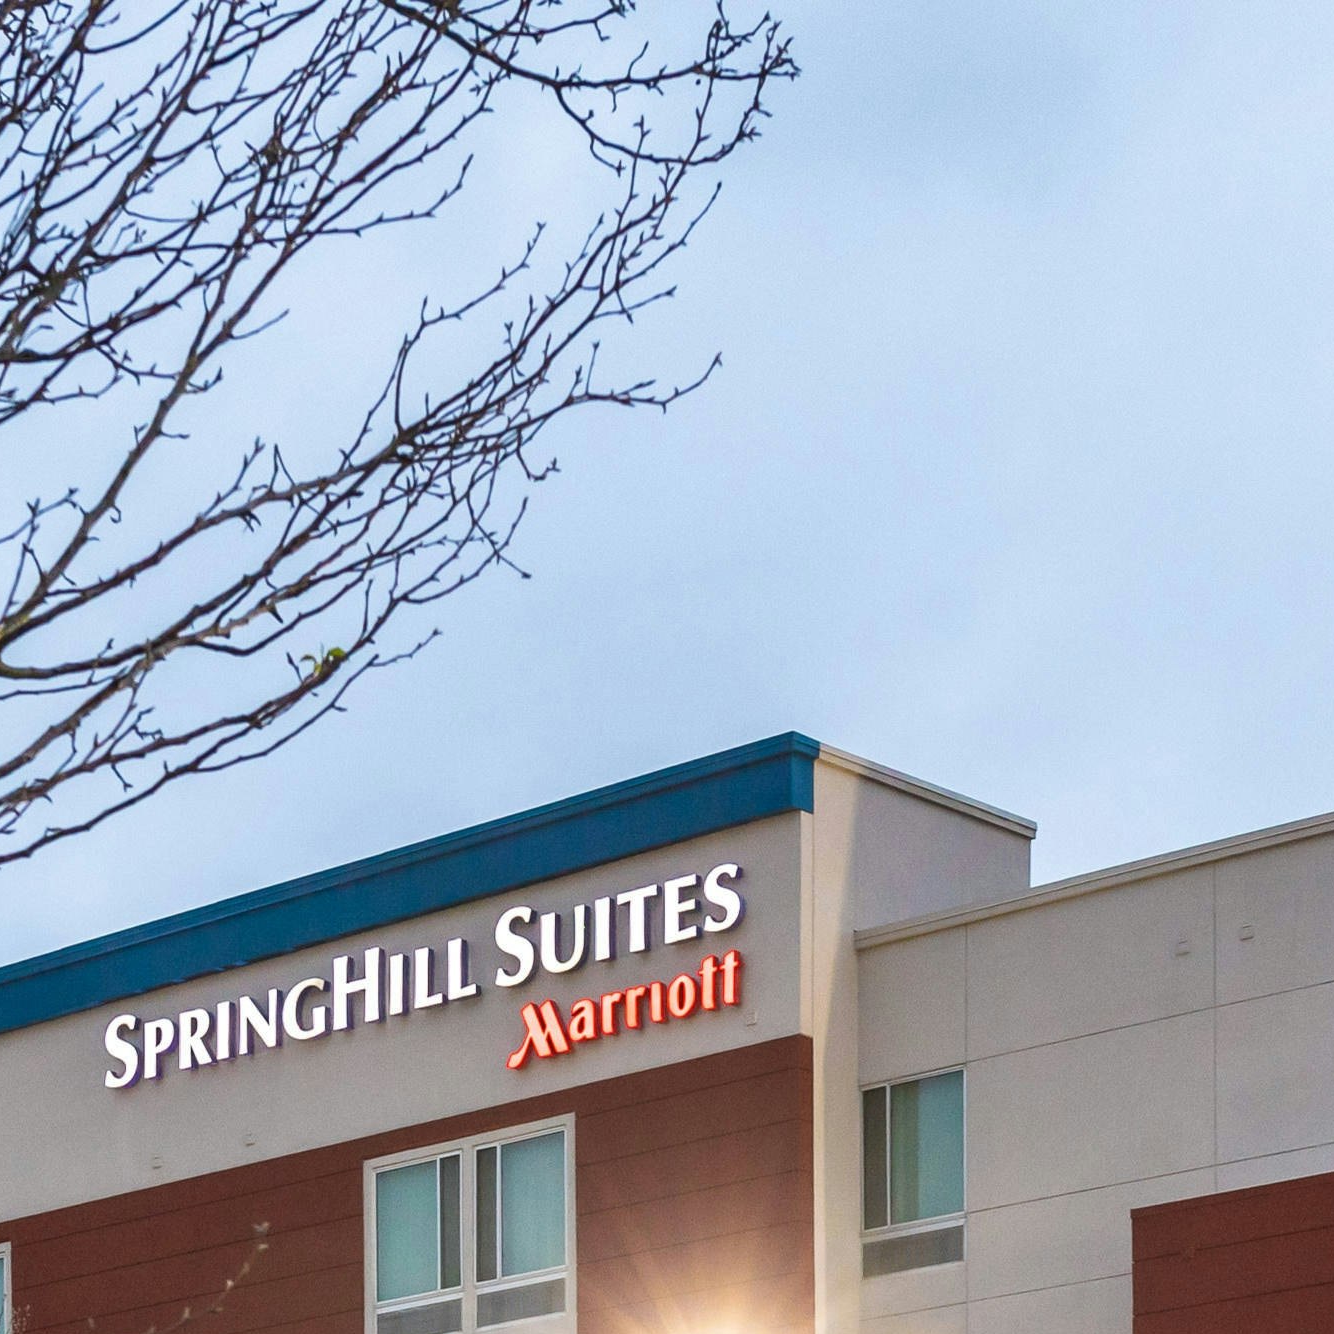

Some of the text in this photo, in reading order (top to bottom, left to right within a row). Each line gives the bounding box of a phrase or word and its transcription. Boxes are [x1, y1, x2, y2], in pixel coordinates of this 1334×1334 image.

[104, 863, 743, 1089] SPRINGHILL SUITES
[505, 949, 743, 1070] Marriott
